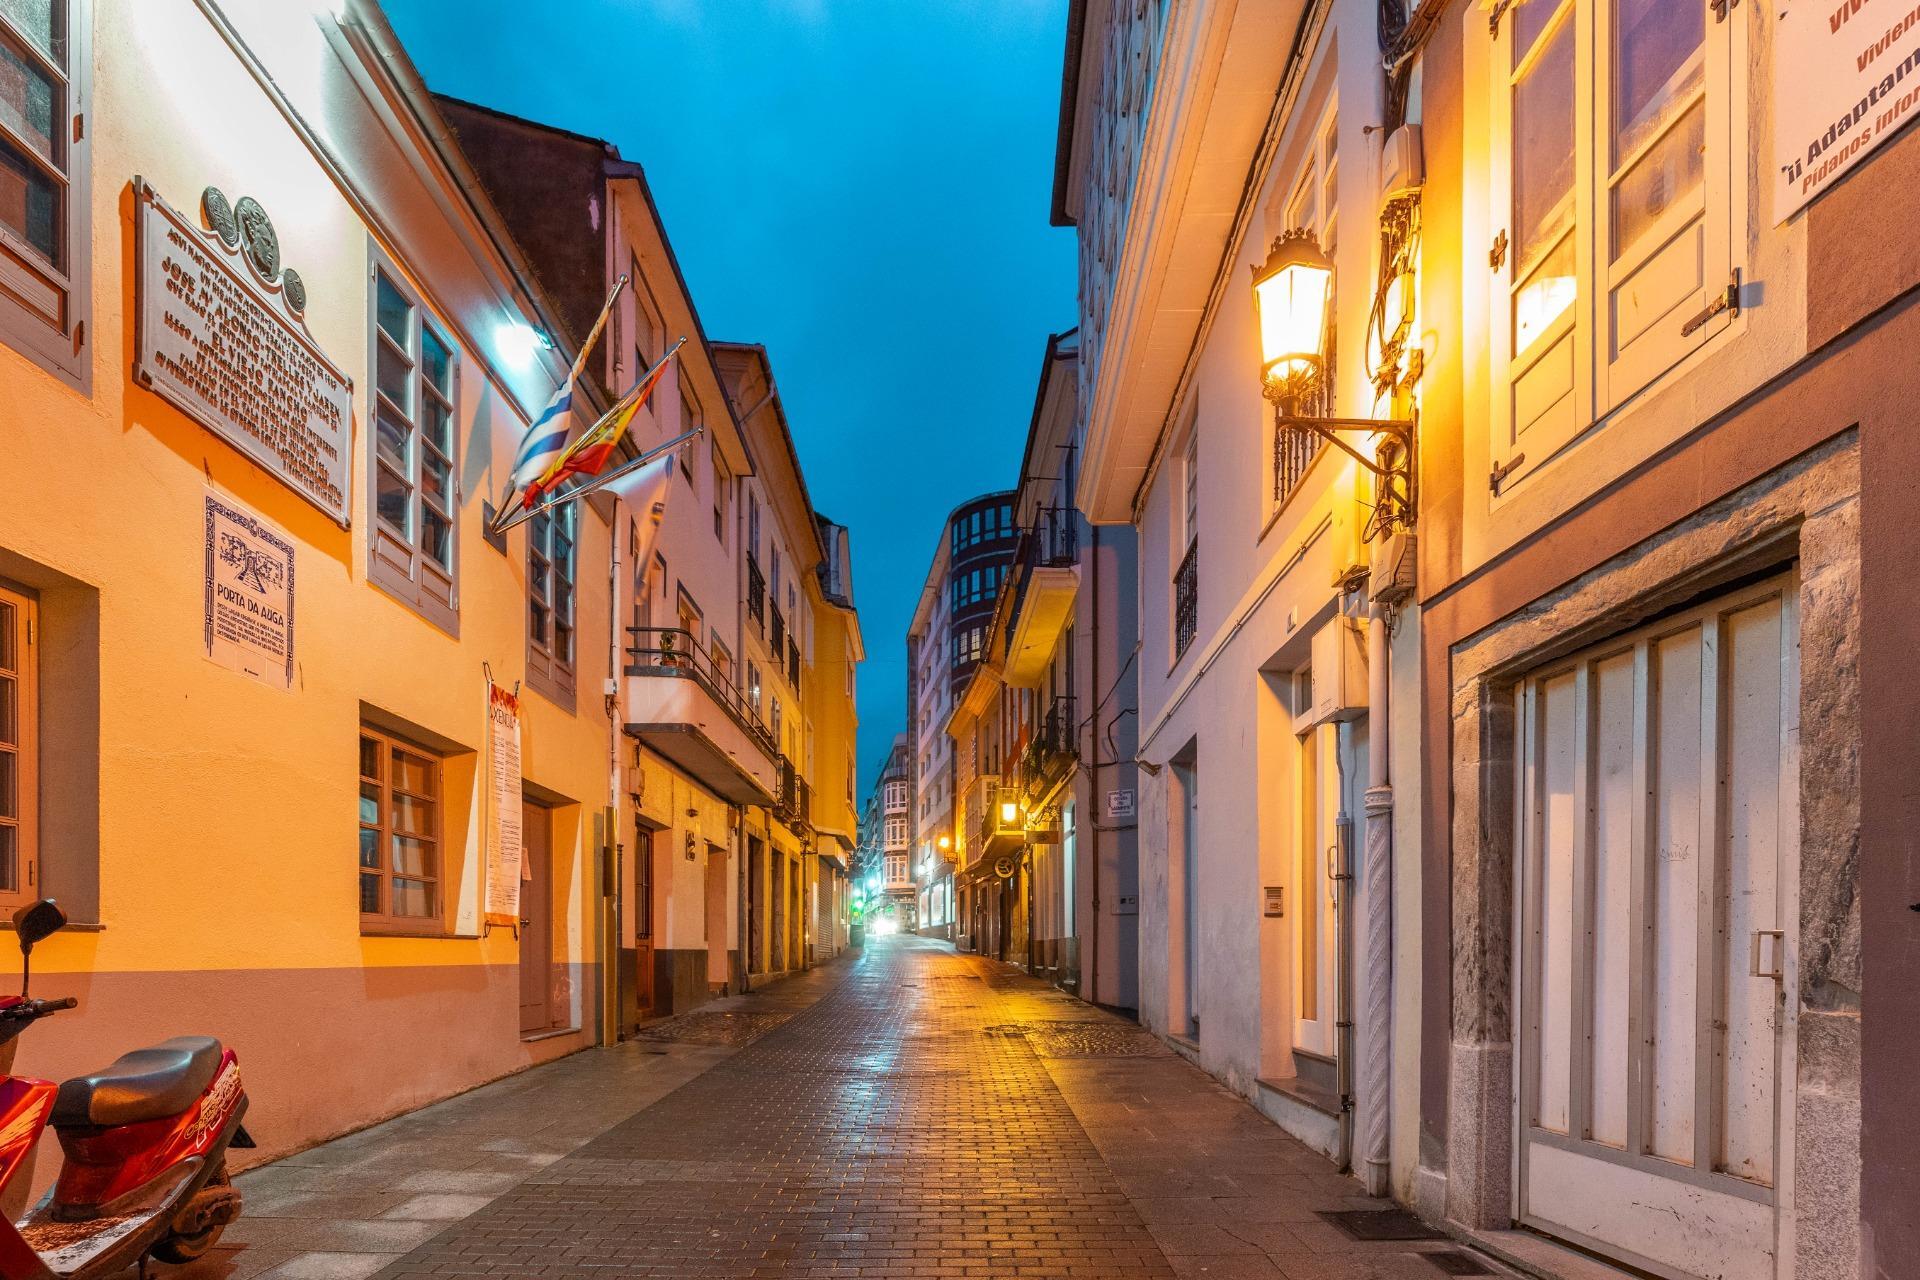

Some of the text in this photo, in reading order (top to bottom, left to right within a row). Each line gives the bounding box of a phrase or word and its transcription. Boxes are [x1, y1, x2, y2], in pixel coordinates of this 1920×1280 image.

[1829, 0, 1869, 35] VIV
[166, 278, 184, 300] QUE
[184, 292, 206, 319] BAJO
[228, 344, 264, 386] VIEJO
[217, 583, 246, 609] PORTA
[247, 598, 259, 616] DA
[260, 606, 284, 628] AUGA
